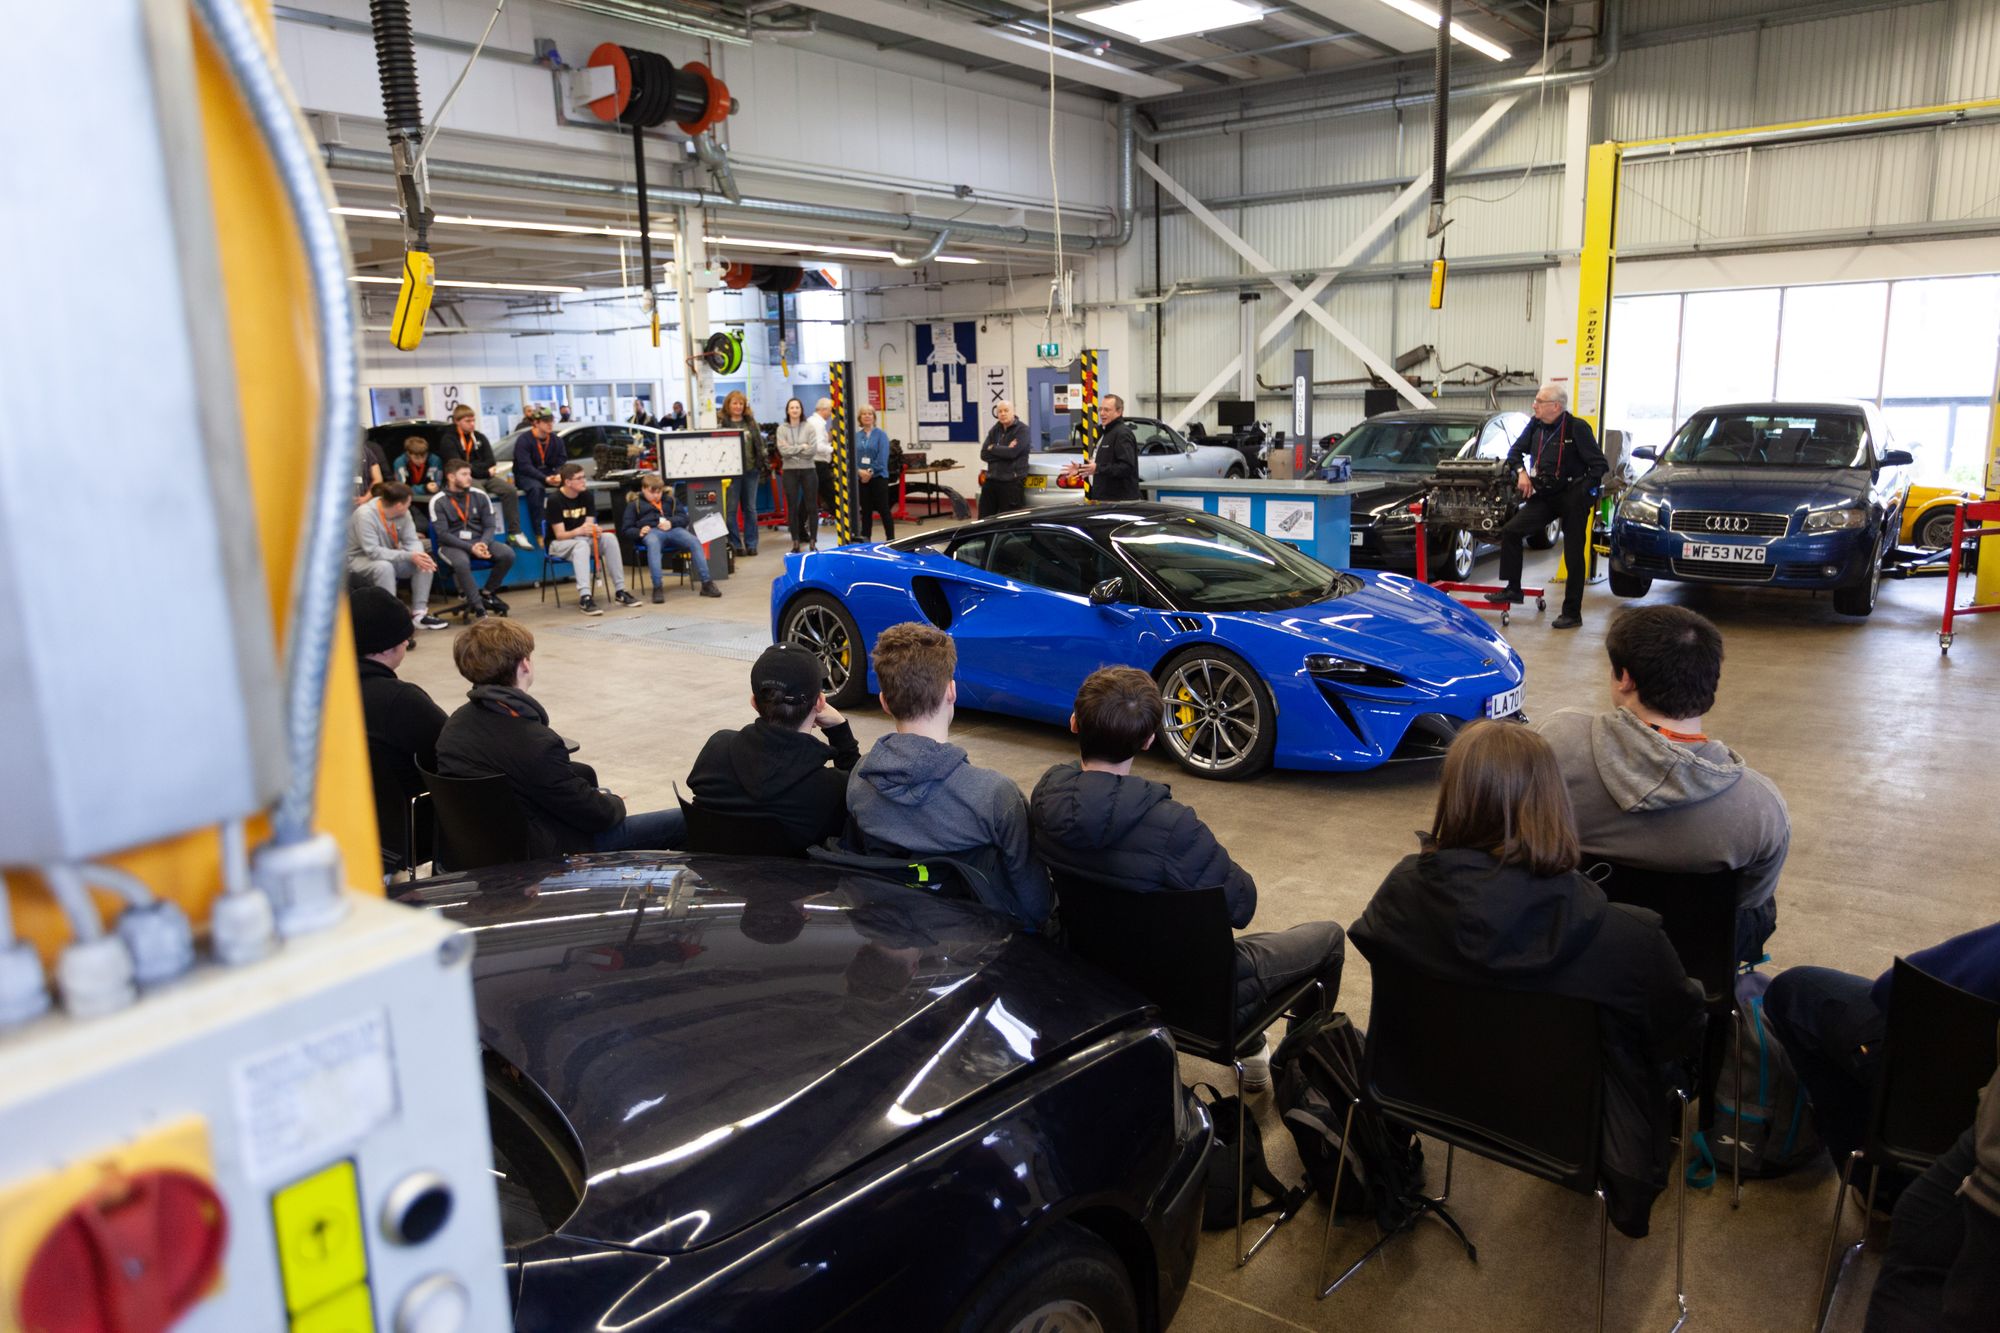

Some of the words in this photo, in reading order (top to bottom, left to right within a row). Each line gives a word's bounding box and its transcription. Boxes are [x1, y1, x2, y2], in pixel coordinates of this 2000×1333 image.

[1584, 320, 1597, 364] DUNLOP
[1692, 545, 1730, 559] WF53
[1733, 547, 1764, 561] NZG
[1494, 690, 1520, 715] LA70
